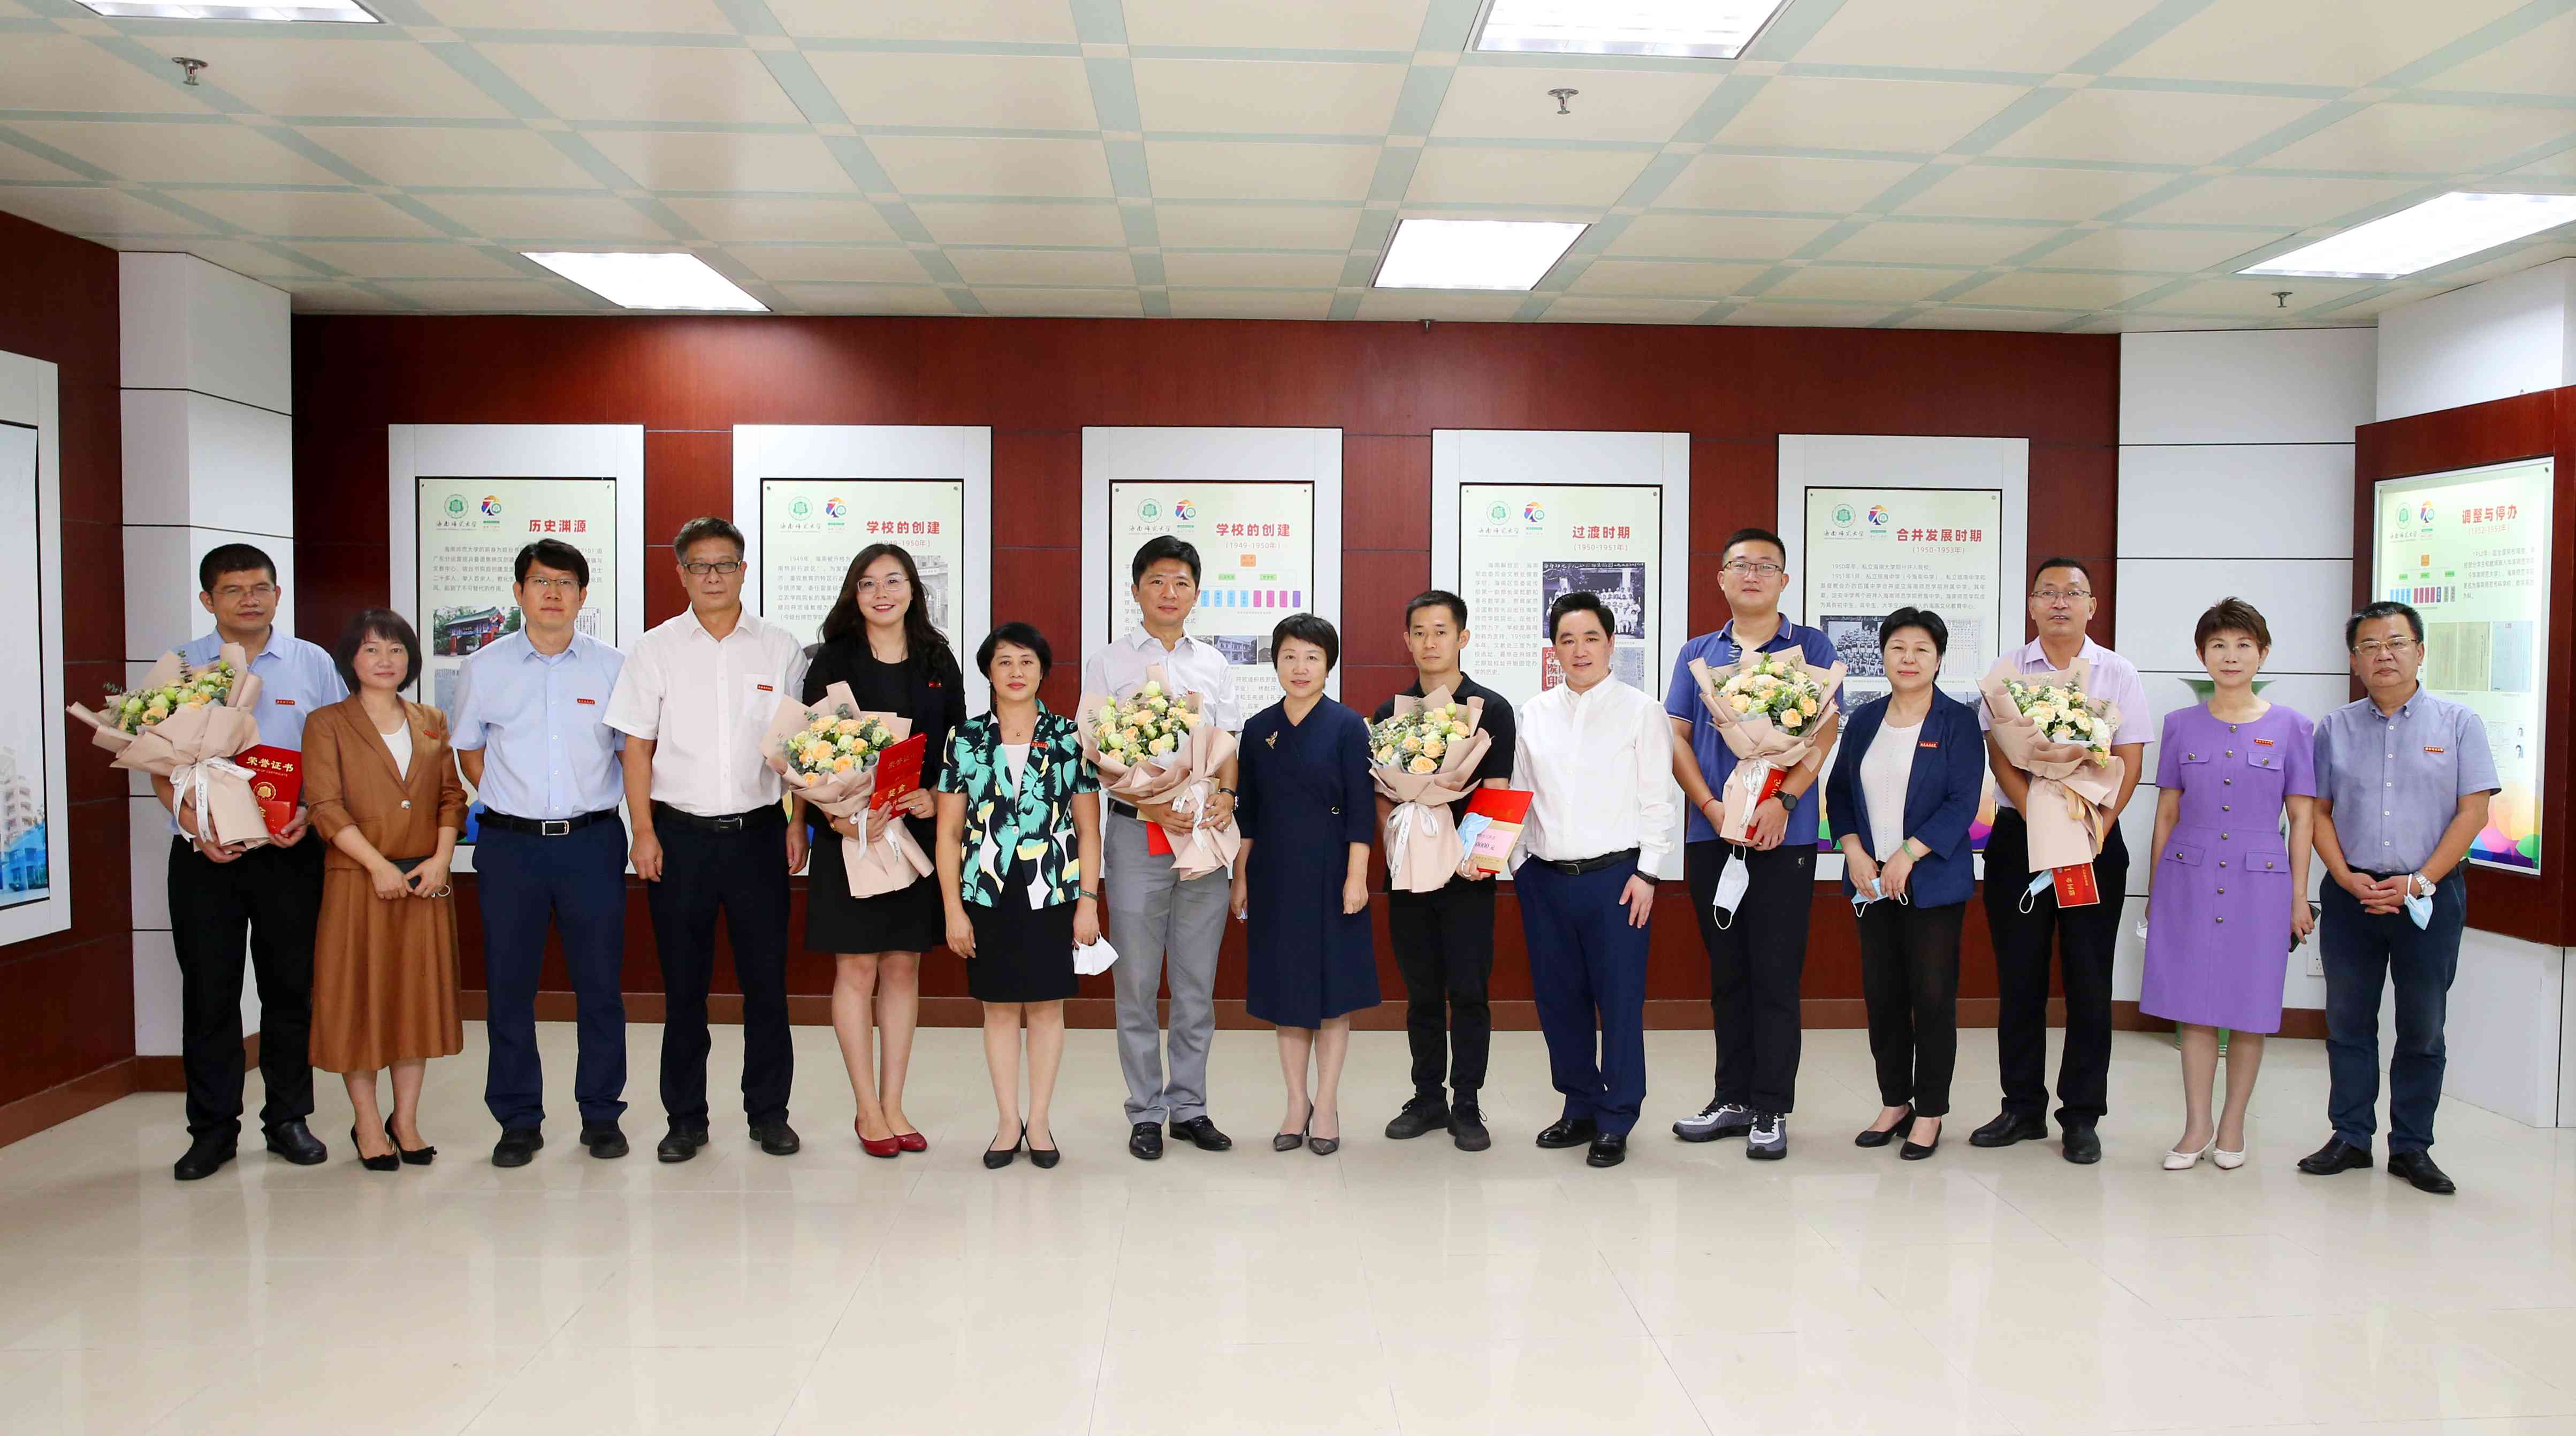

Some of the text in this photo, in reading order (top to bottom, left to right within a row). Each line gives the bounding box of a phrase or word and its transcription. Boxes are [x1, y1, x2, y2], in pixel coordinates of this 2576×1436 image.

[2462, 505, 2517, 524] 调整与停办
[529, 520, 586, 532] 历史渊源
[867, 521, 940, 534] 学校的创建
[1216, 523, 1290, 537] 学校的创建
[1573, 526, 1629, 539] 过渡时期
[1897, 529, 1981, 541] 合并发展时期
[246, 756, 294, 772] 荣誉证书
